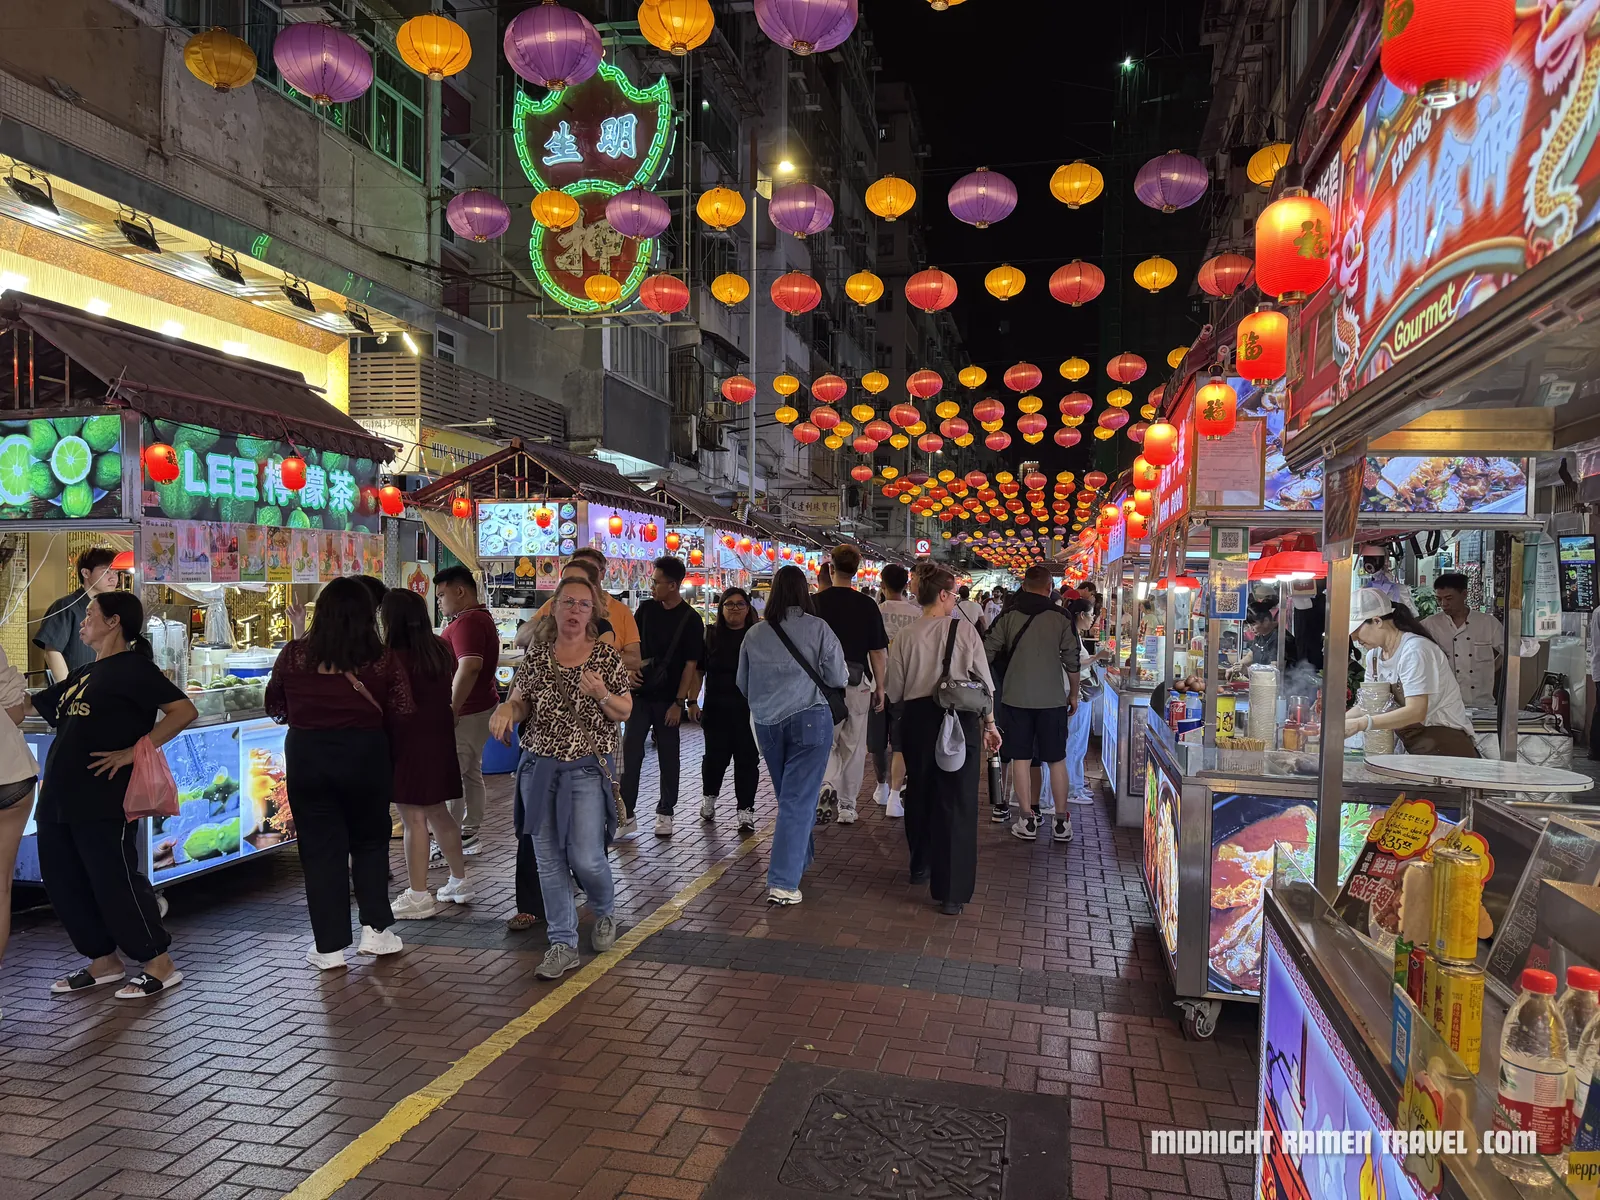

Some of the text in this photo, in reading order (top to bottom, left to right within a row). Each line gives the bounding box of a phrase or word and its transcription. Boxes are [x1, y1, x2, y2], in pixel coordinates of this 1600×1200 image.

[1391, 108, 1432, 185] Hong
[1364, 64, 1529, 321] 民間食神
[1394, 282, 1456, 352] Gourmet
[1203, 399, 1226, 421] 福
[183, 449, 258, 500] LEE
[920, 543, 927, 551] K
